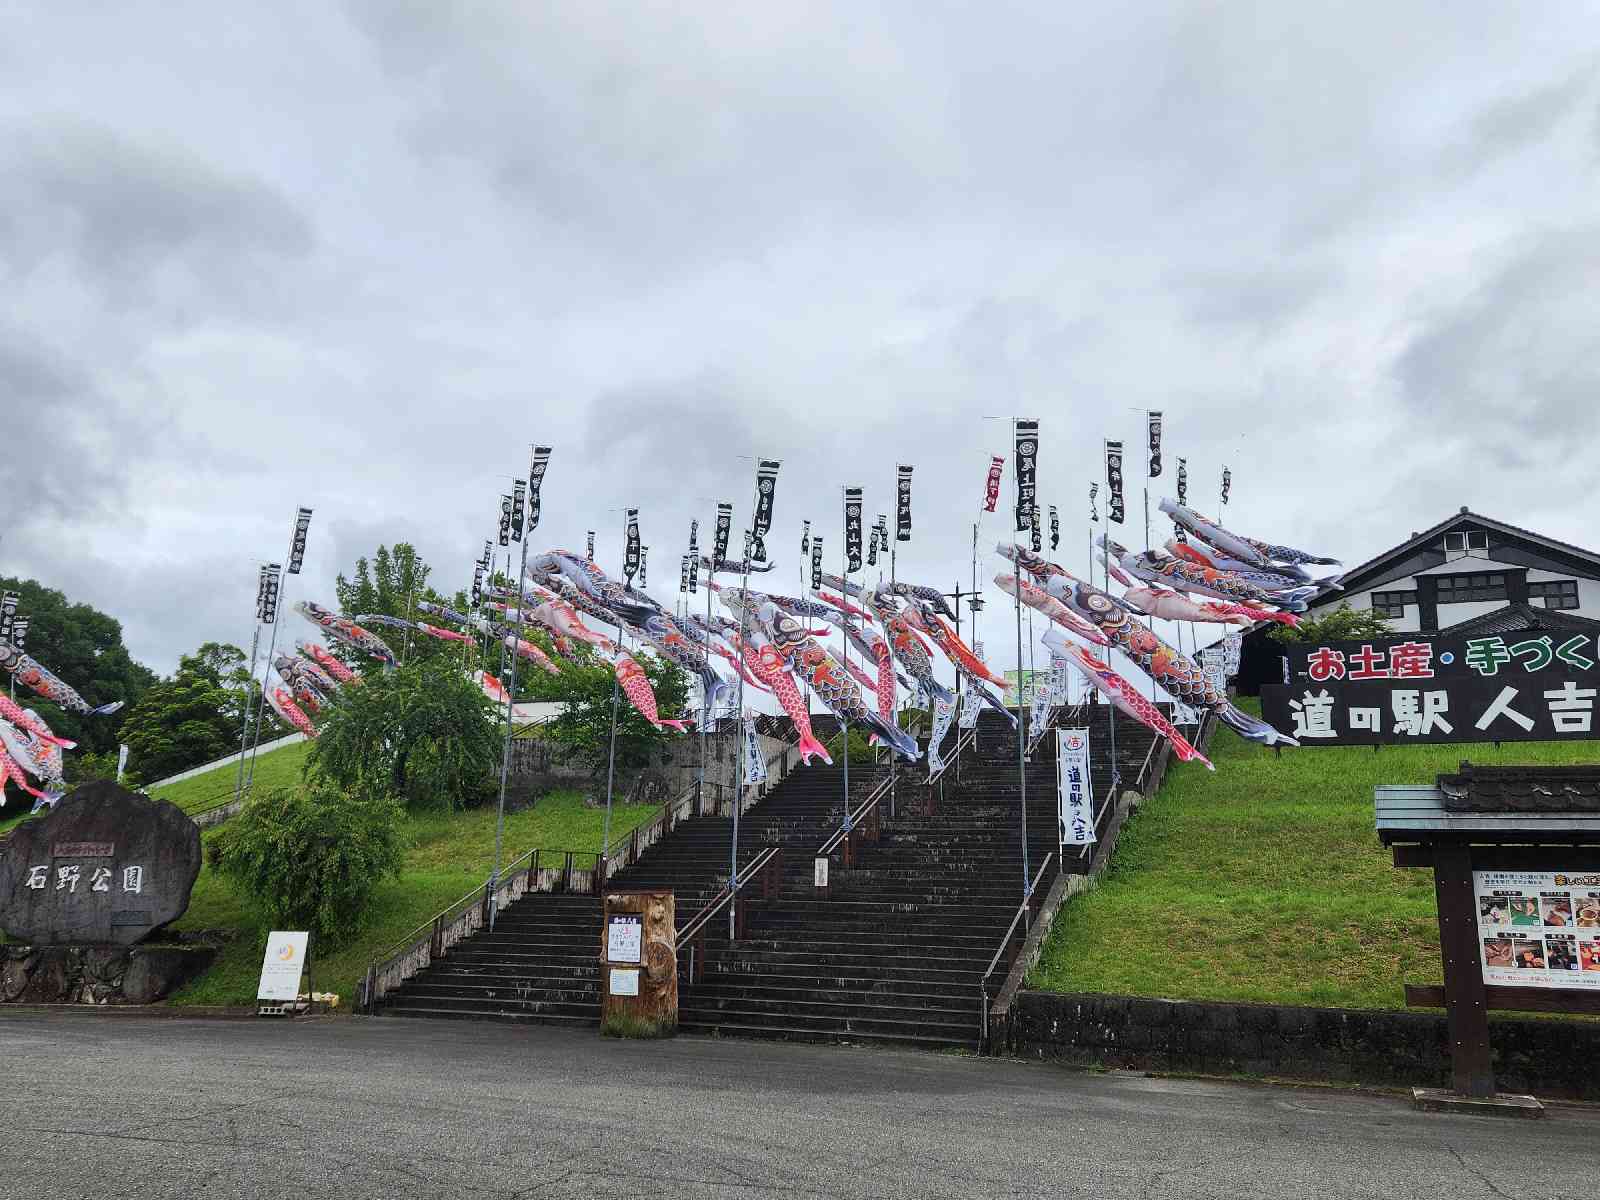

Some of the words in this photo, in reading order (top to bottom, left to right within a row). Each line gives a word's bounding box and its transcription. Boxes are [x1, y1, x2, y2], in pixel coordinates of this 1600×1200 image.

[1308, 633, 1600, 681] お土産・手づく
[1288, 681, 1597, 739] 道の駅人吉
[1067, 766, 1086, 841] 道の駅人吉
[25, 865, 143, 894] 石野公園
